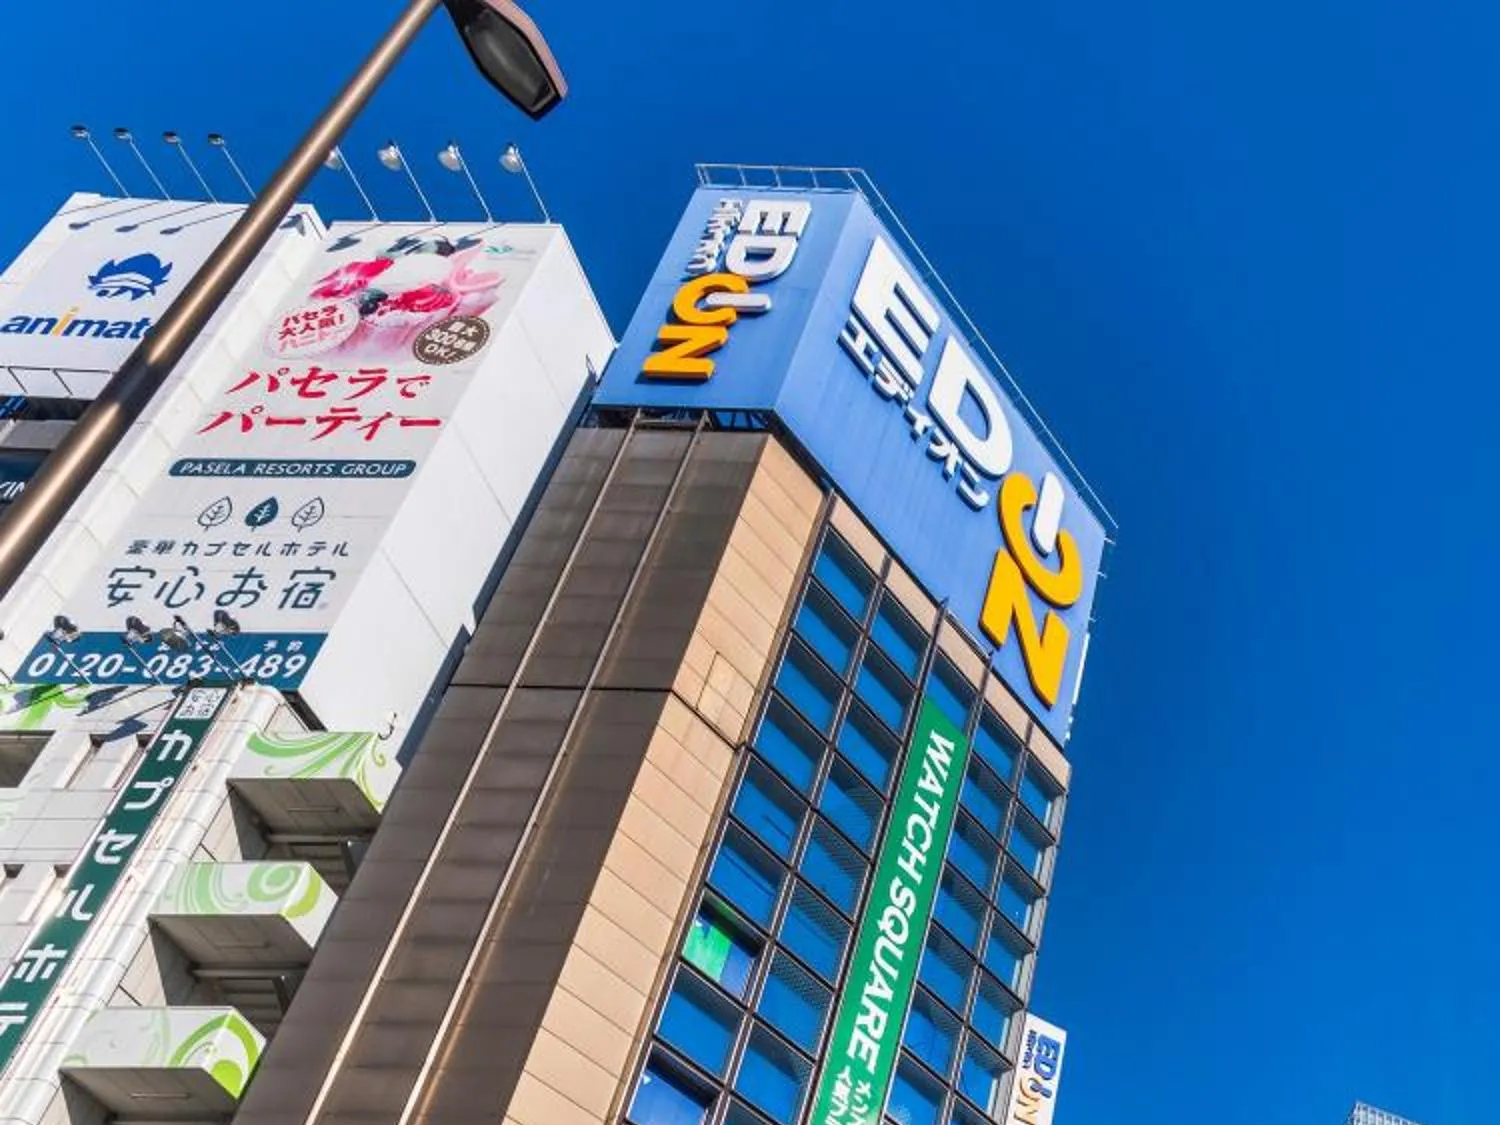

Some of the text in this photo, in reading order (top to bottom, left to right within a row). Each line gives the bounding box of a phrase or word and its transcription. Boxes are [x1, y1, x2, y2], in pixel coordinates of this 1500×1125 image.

[643, 199, 812, 381] EDION
[2, 307, 153, 340] animat
[226, 366, 432, 400] パセラで
[197, 405, 442, 441] パーティー
[838, 315, 990, 511] エディオン
[180, 463, 407, 477] PASELA RESORTS GROUP
[850, 236, 1083, 710] EDION
[107, 566, 337, 610] 安心お宿
[28, 653, 308, 679] 0120-083-489
[847, 730, 955, 1075] WATCH SQUARE
